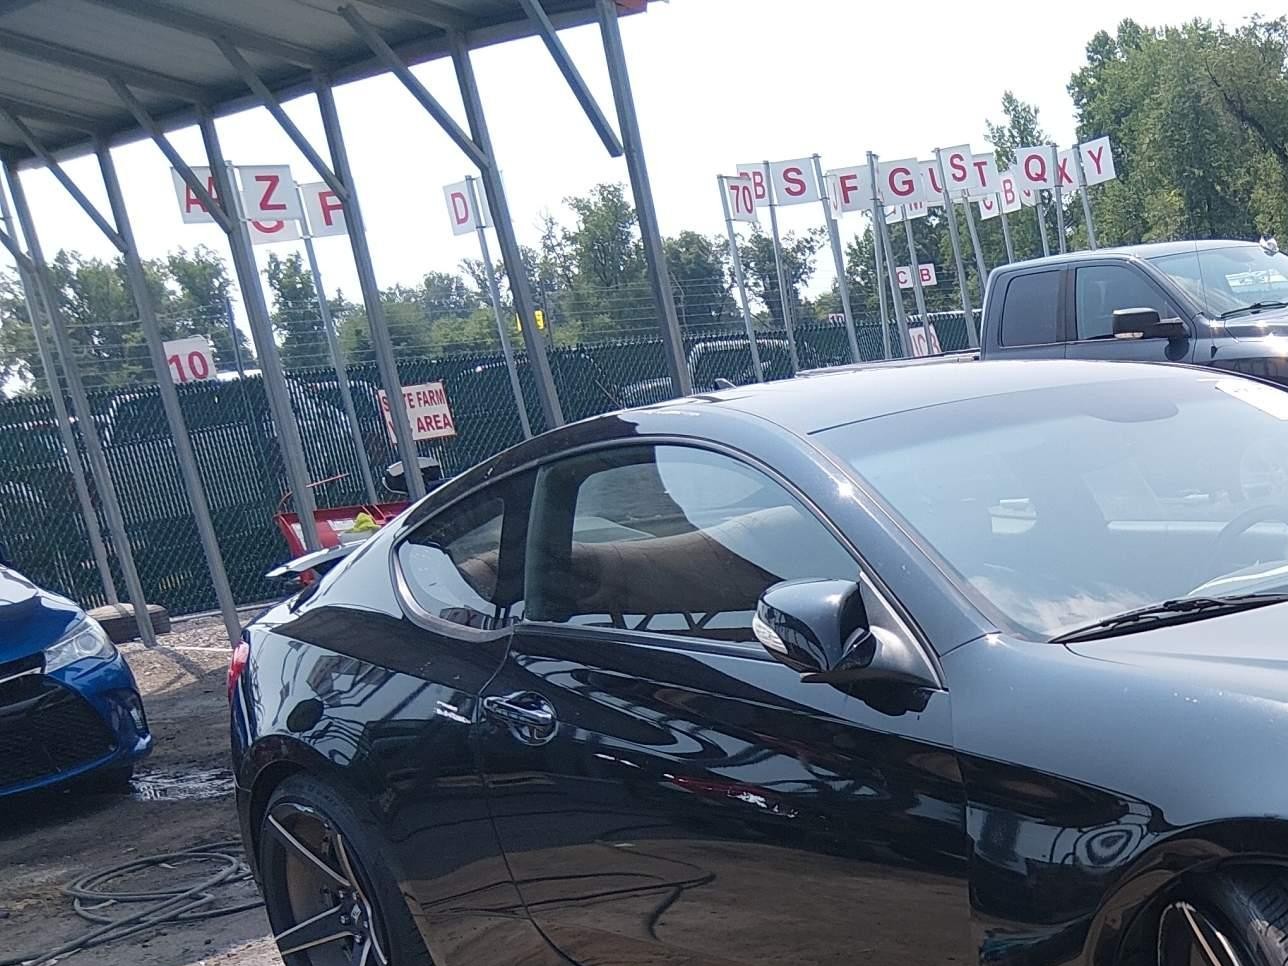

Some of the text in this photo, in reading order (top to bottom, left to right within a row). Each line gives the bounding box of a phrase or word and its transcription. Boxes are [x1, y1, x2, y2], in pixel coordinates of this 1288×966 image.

[949, 153, 967, 183] S
[972, 161, 988, 188] T
[1024, 154, 1048, 183] Q
[1087, 146, 1103, 175] Y
[254, 175, 287, 211] Z
[783, 167, 807, 197] S
[839, 174, 859, 204] F
[888, 167, 915, 197] G
[1003, 178, 1016, 205] B
[450, 191, 469, 225] D
[730, 185, 754, 215] 70
[168, 351, 209, 382] 10
[415, 388, 446, 408] FARM
[416, 413, 453, 433] AREA
